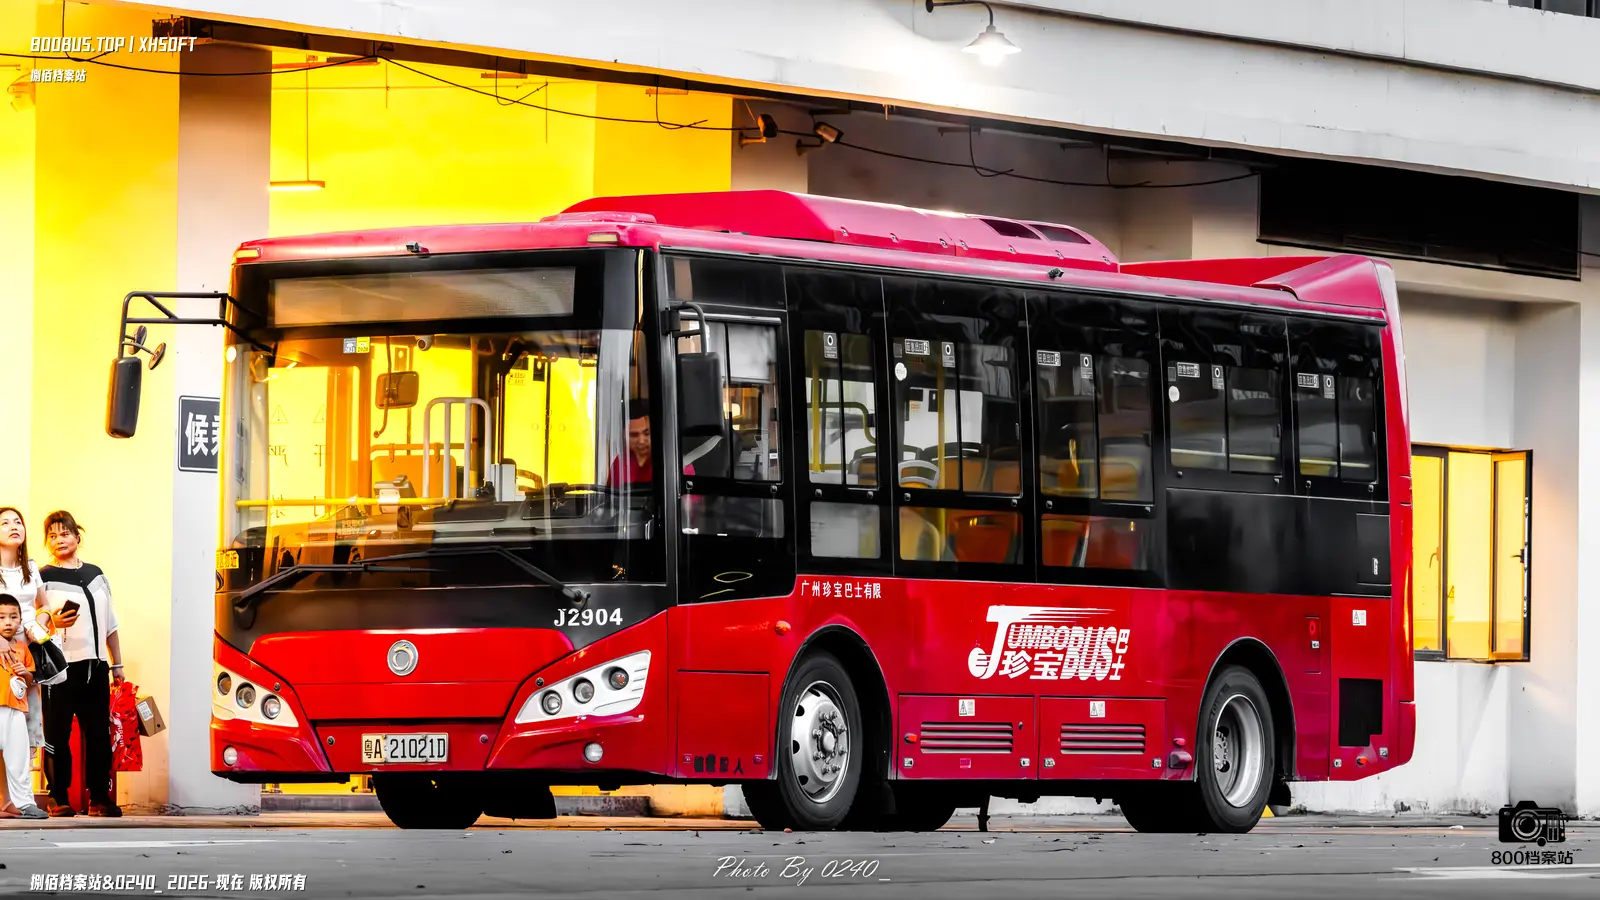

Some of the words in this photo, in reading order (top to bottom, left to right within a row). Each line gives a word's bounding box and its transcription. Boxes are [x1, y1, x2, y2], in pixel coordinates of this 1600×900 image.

[801, 580, 882, 599] 广州珍宝巴士有限
[553, 607, 624, 627] J2904
